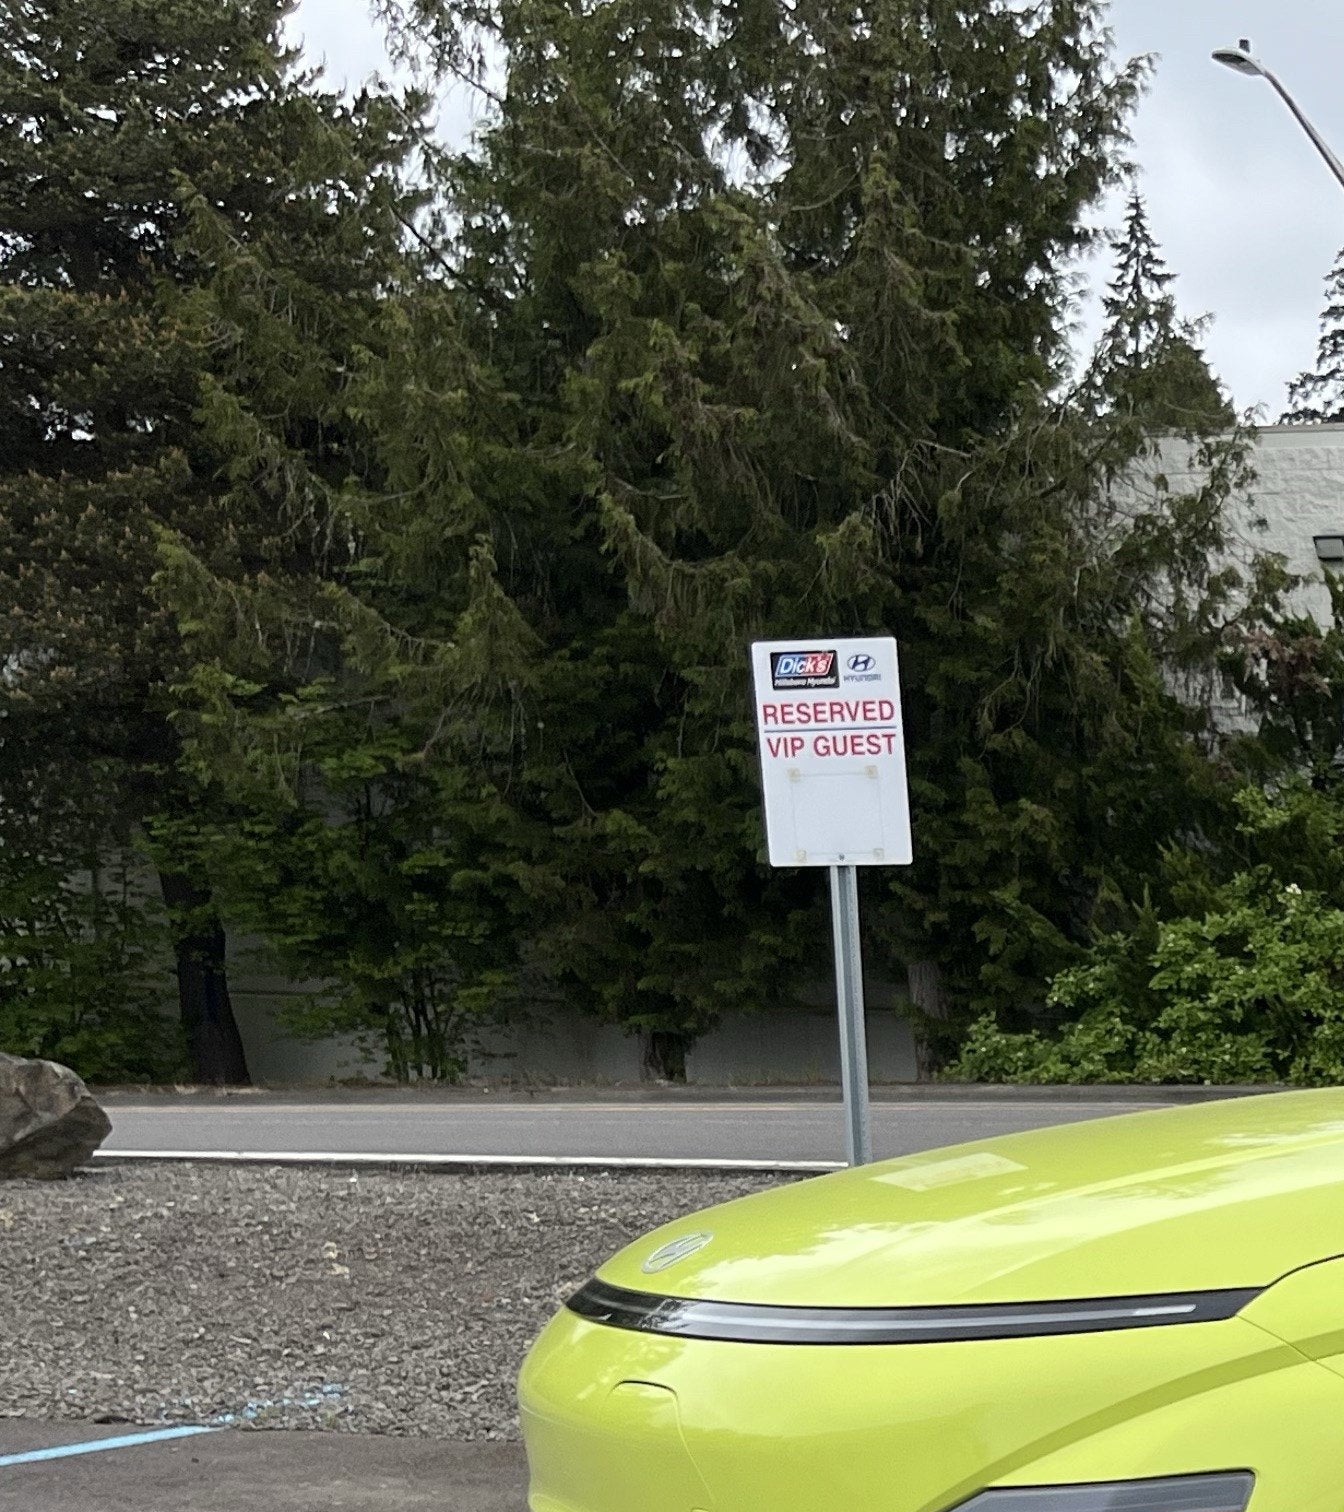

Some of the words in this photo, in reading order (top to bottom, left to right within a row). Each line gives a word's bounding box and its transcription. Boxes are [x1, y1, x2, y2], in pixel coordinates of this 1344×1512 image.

[762, 699, 896, 726] RESERVED
[766, 735, 805, 759] VIP
[813, 733, 896, 757] GUEST
